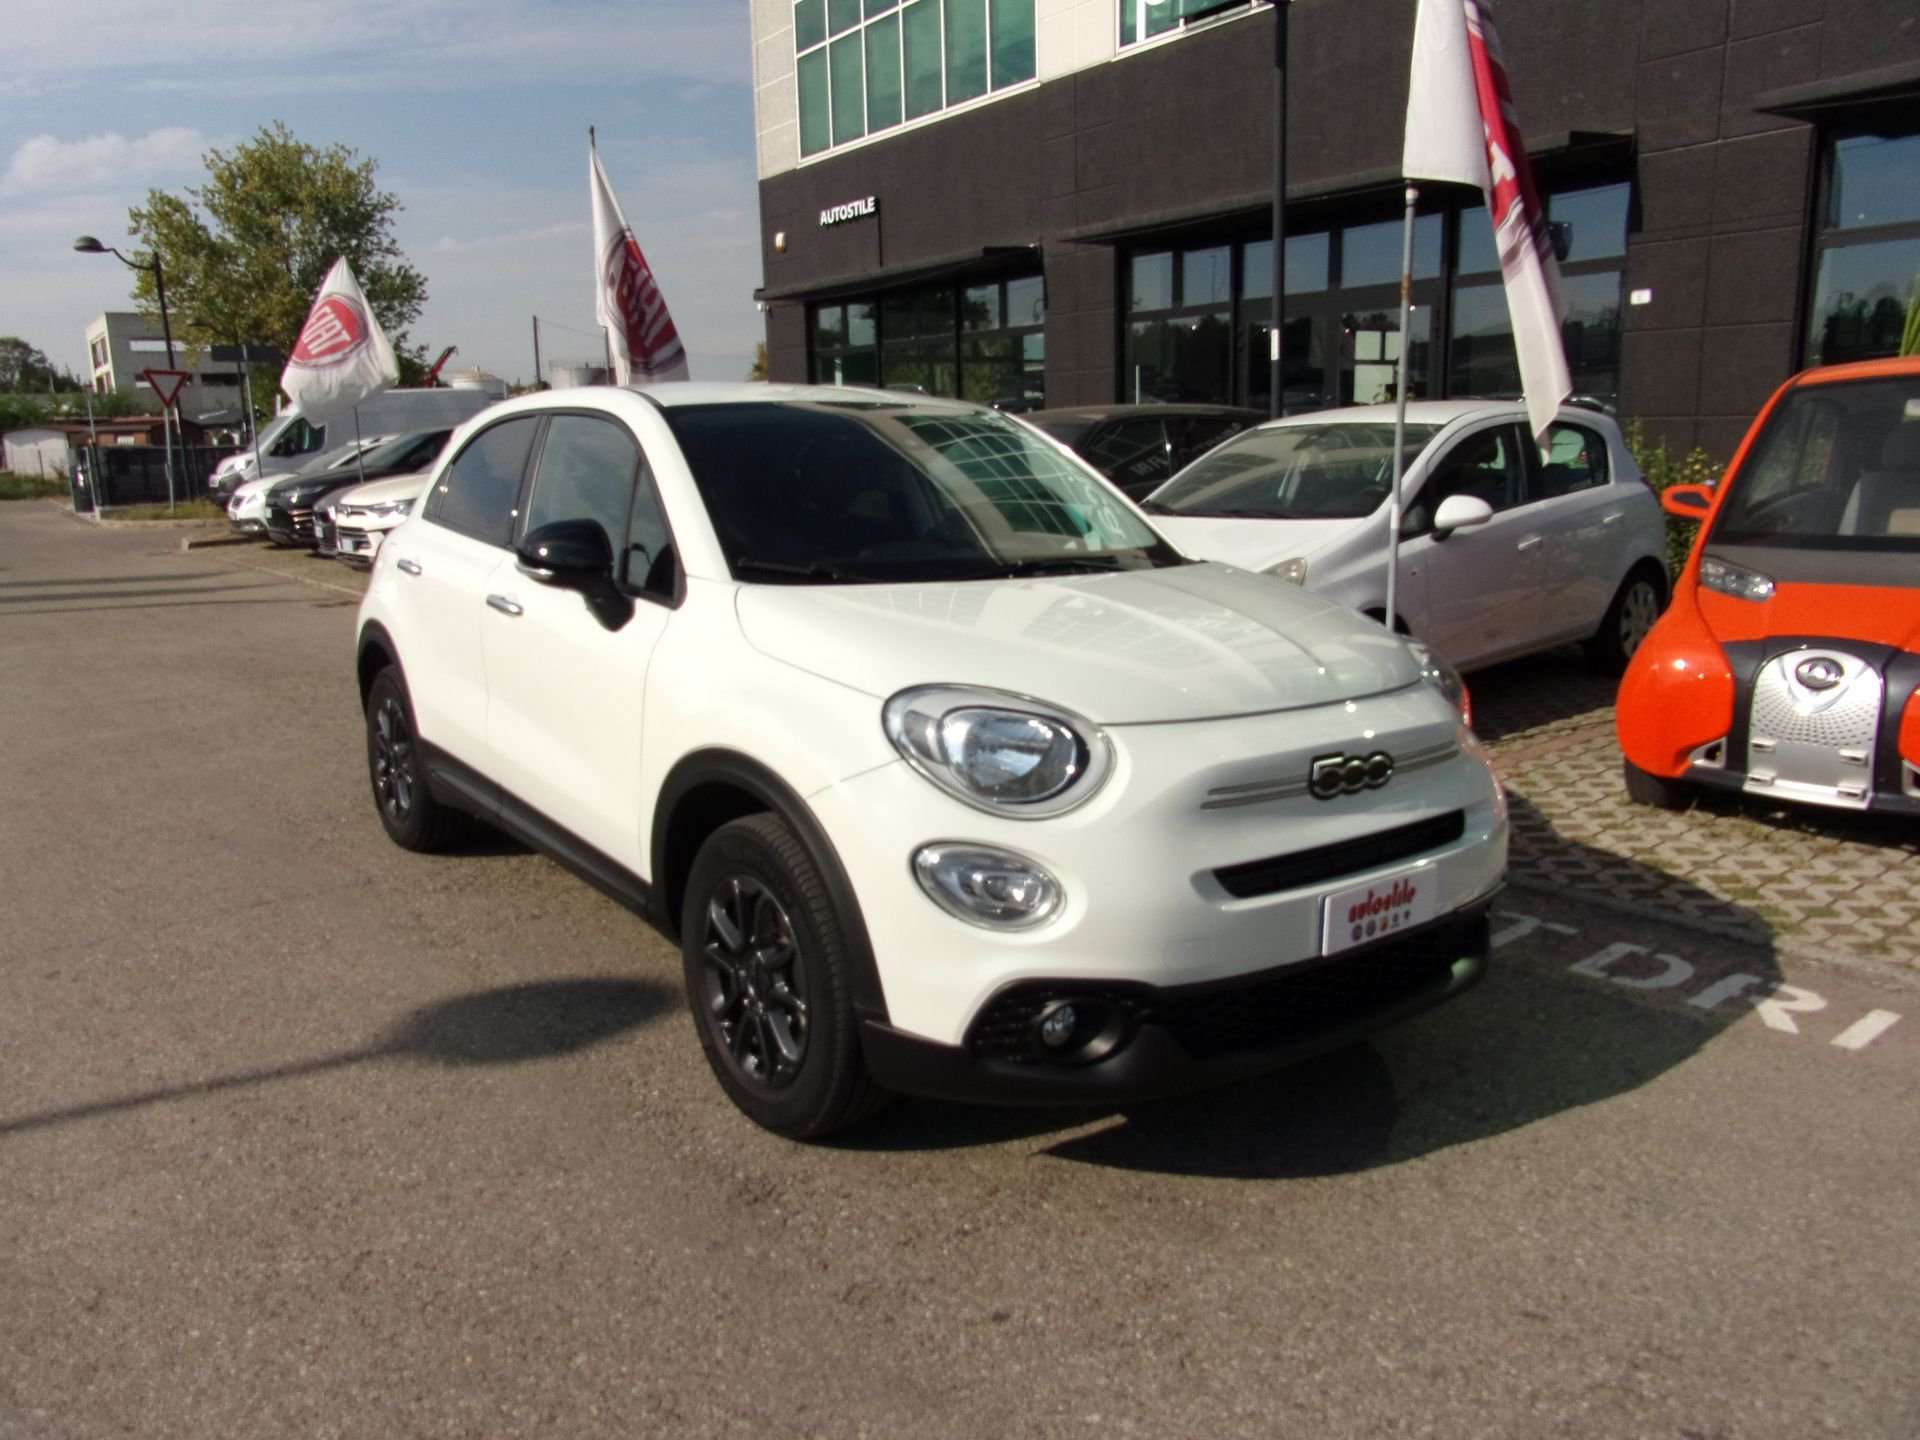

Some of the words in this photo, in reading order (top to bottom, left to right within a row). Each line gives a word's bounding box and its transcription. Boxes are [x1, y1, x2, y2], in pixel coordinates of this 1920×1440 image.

[819, 196, 876, 227] AUTOSTILE
[301, 304, 352, 356] FIAT
[1310, 751, 1394, 800] 500
